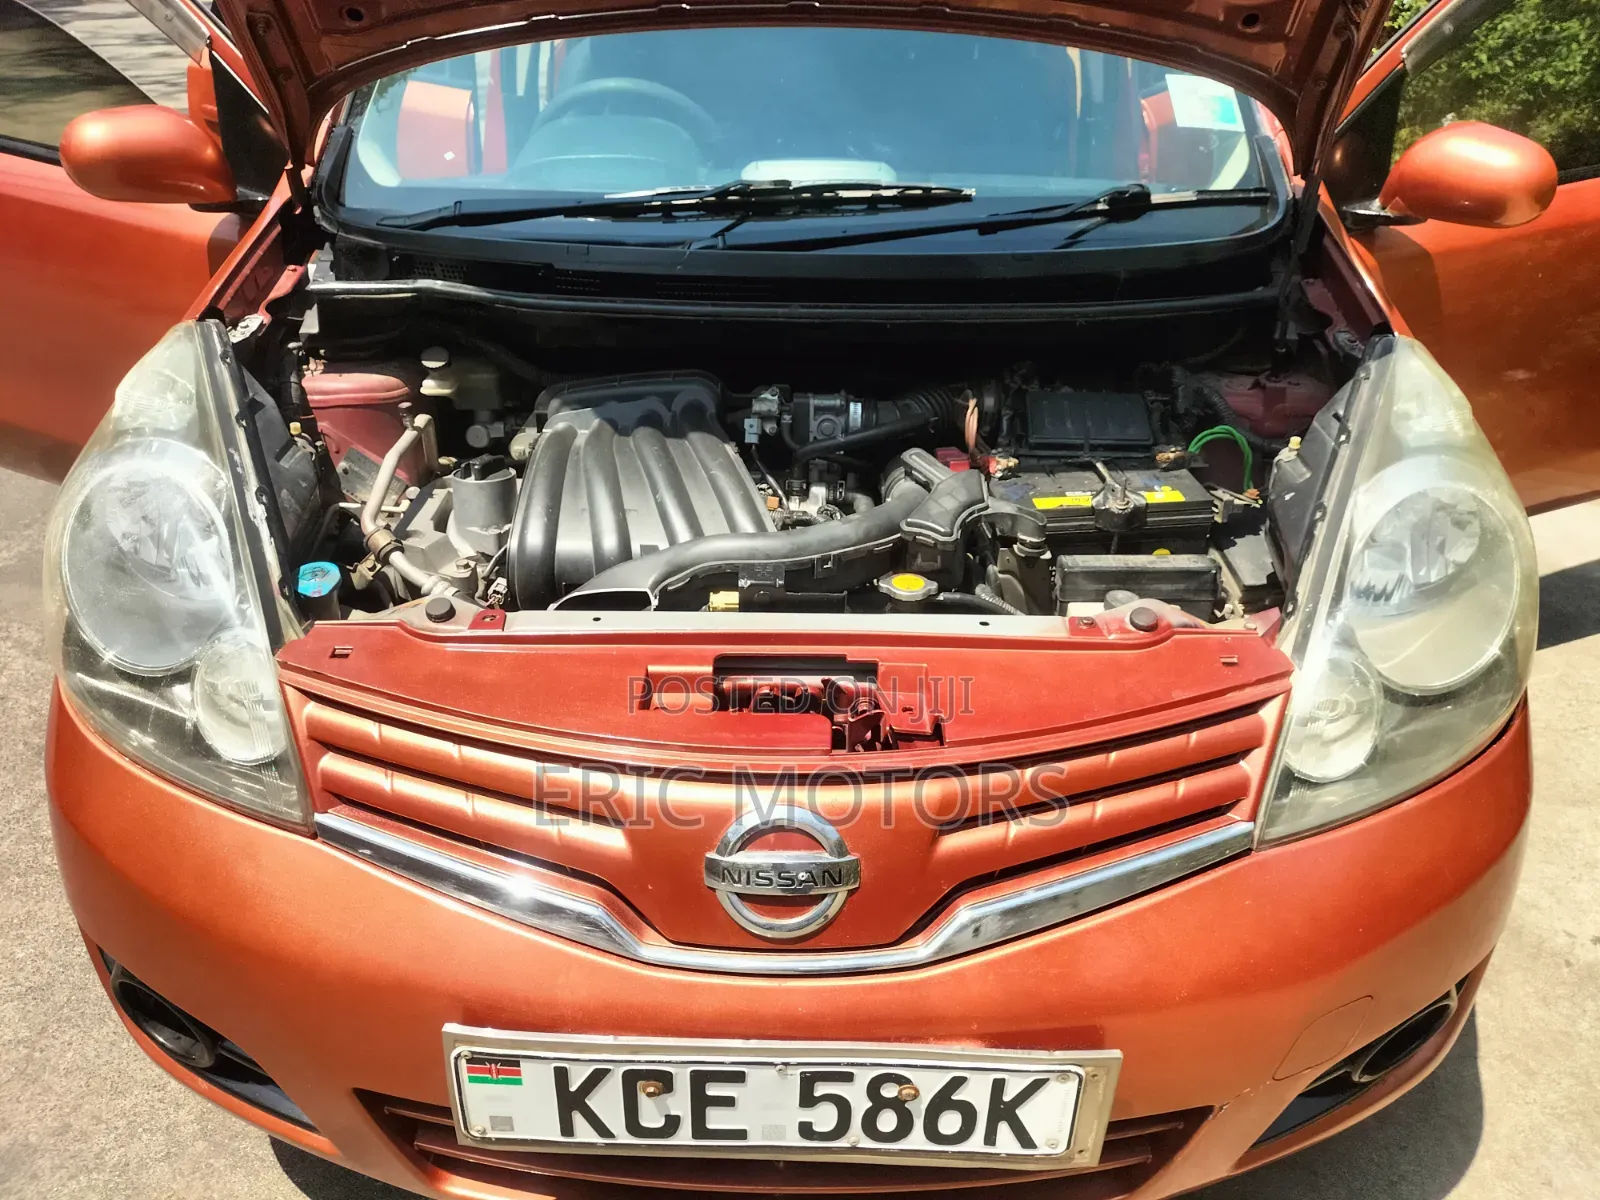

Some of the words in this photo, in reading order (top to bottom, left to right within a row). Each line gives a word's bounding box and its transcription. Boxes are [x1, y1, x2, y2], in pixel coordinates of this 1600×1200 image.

[721, 867, 843, 888] NISSAN
[553, 1065, 748, 1140] KCE
[798, 1071, 1050, 1149] 586K
